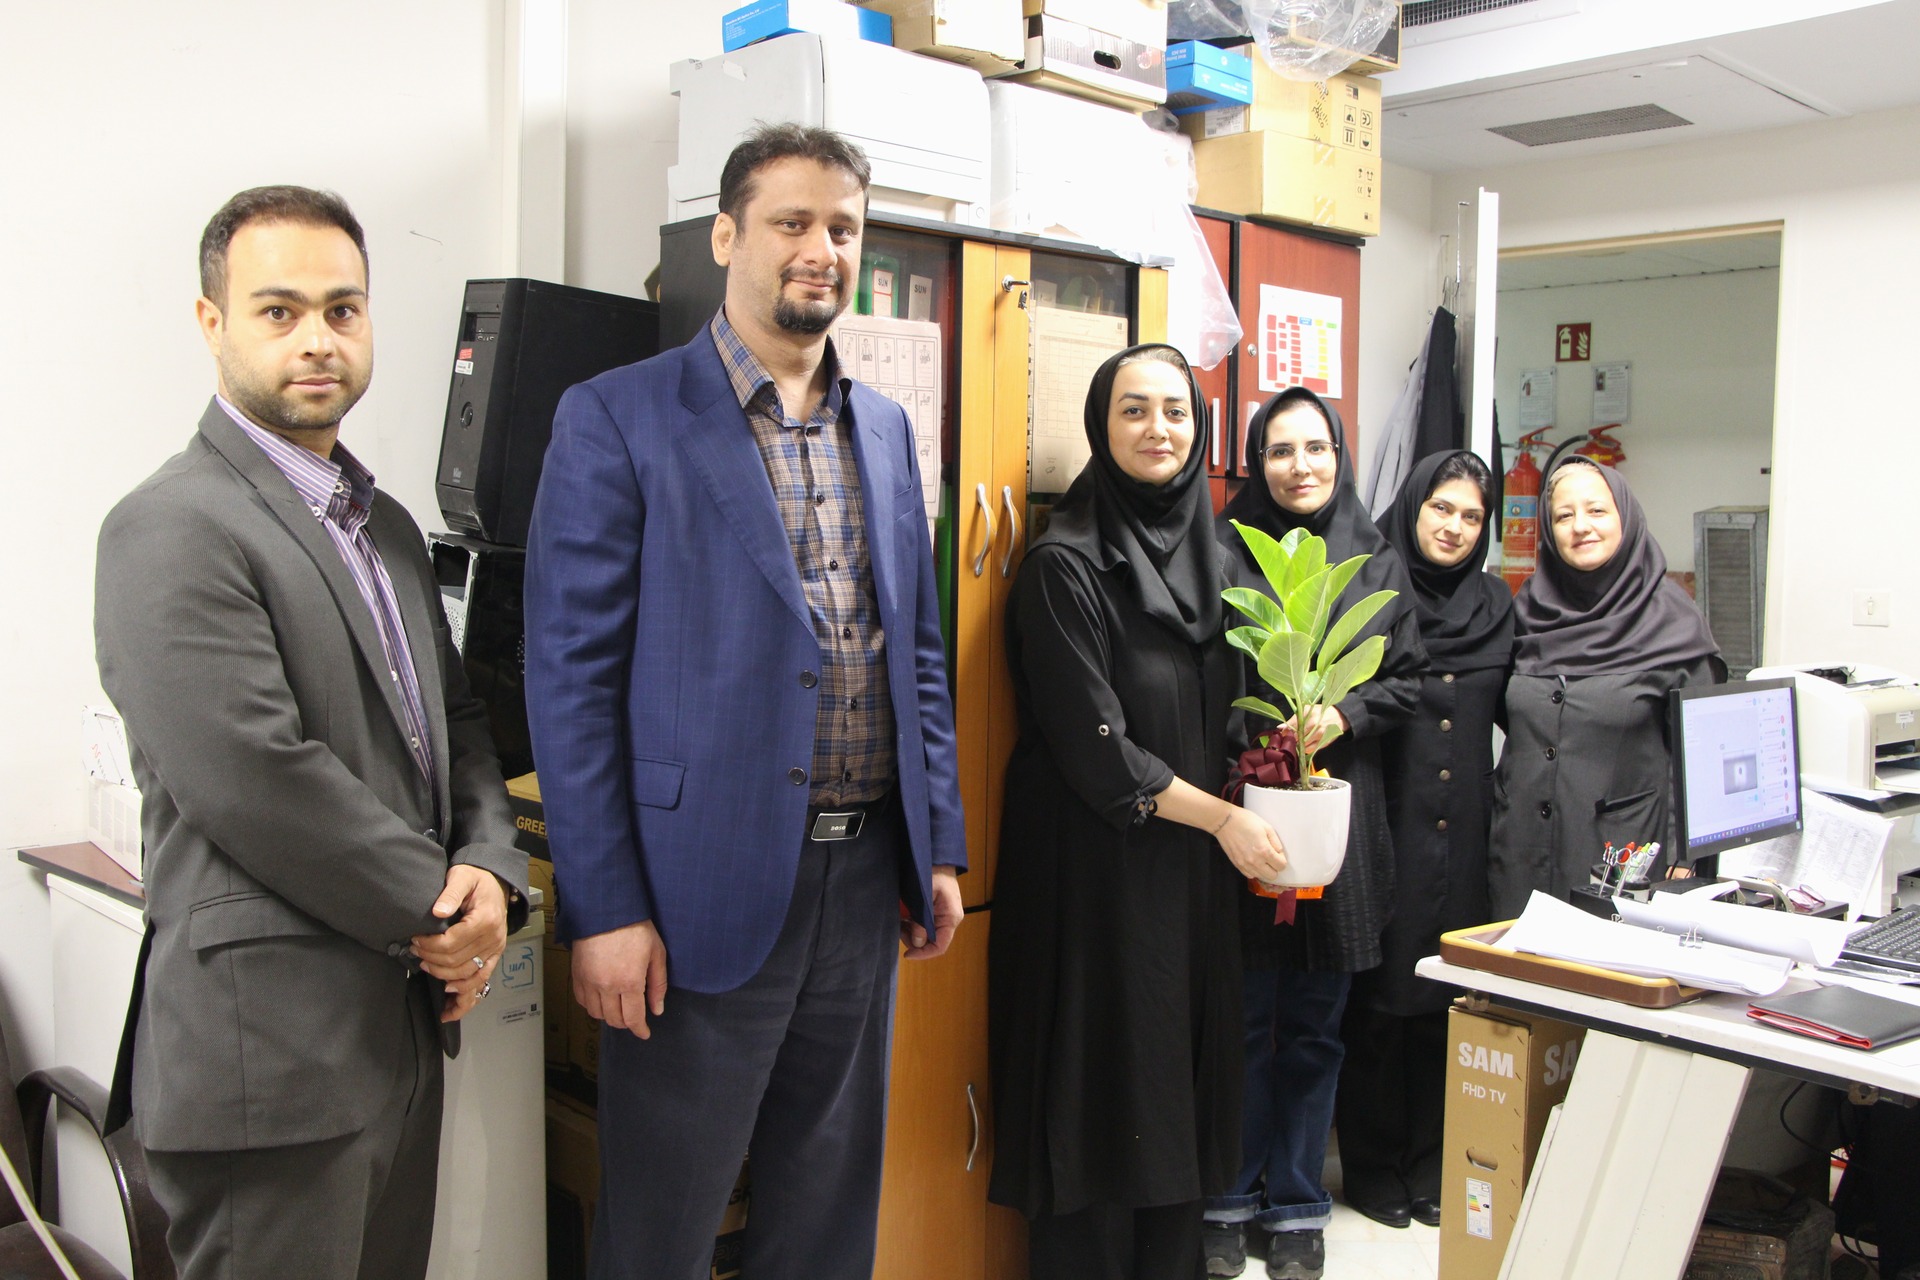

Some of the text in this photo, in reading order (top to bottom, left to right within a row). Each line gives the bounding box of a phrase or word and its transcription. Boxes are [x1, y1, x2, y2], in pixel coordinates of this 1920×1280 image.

[878, 278, 888, 287] SUN
[914, 284, 927, 294] SUN
[516, 816, 547, 836] GREE
[1458, 1042, 1514, 1078] SAM
[1544, 1041, 1578, 1085] SA
[1462, 1082, 1506, 1104] FHD TV
